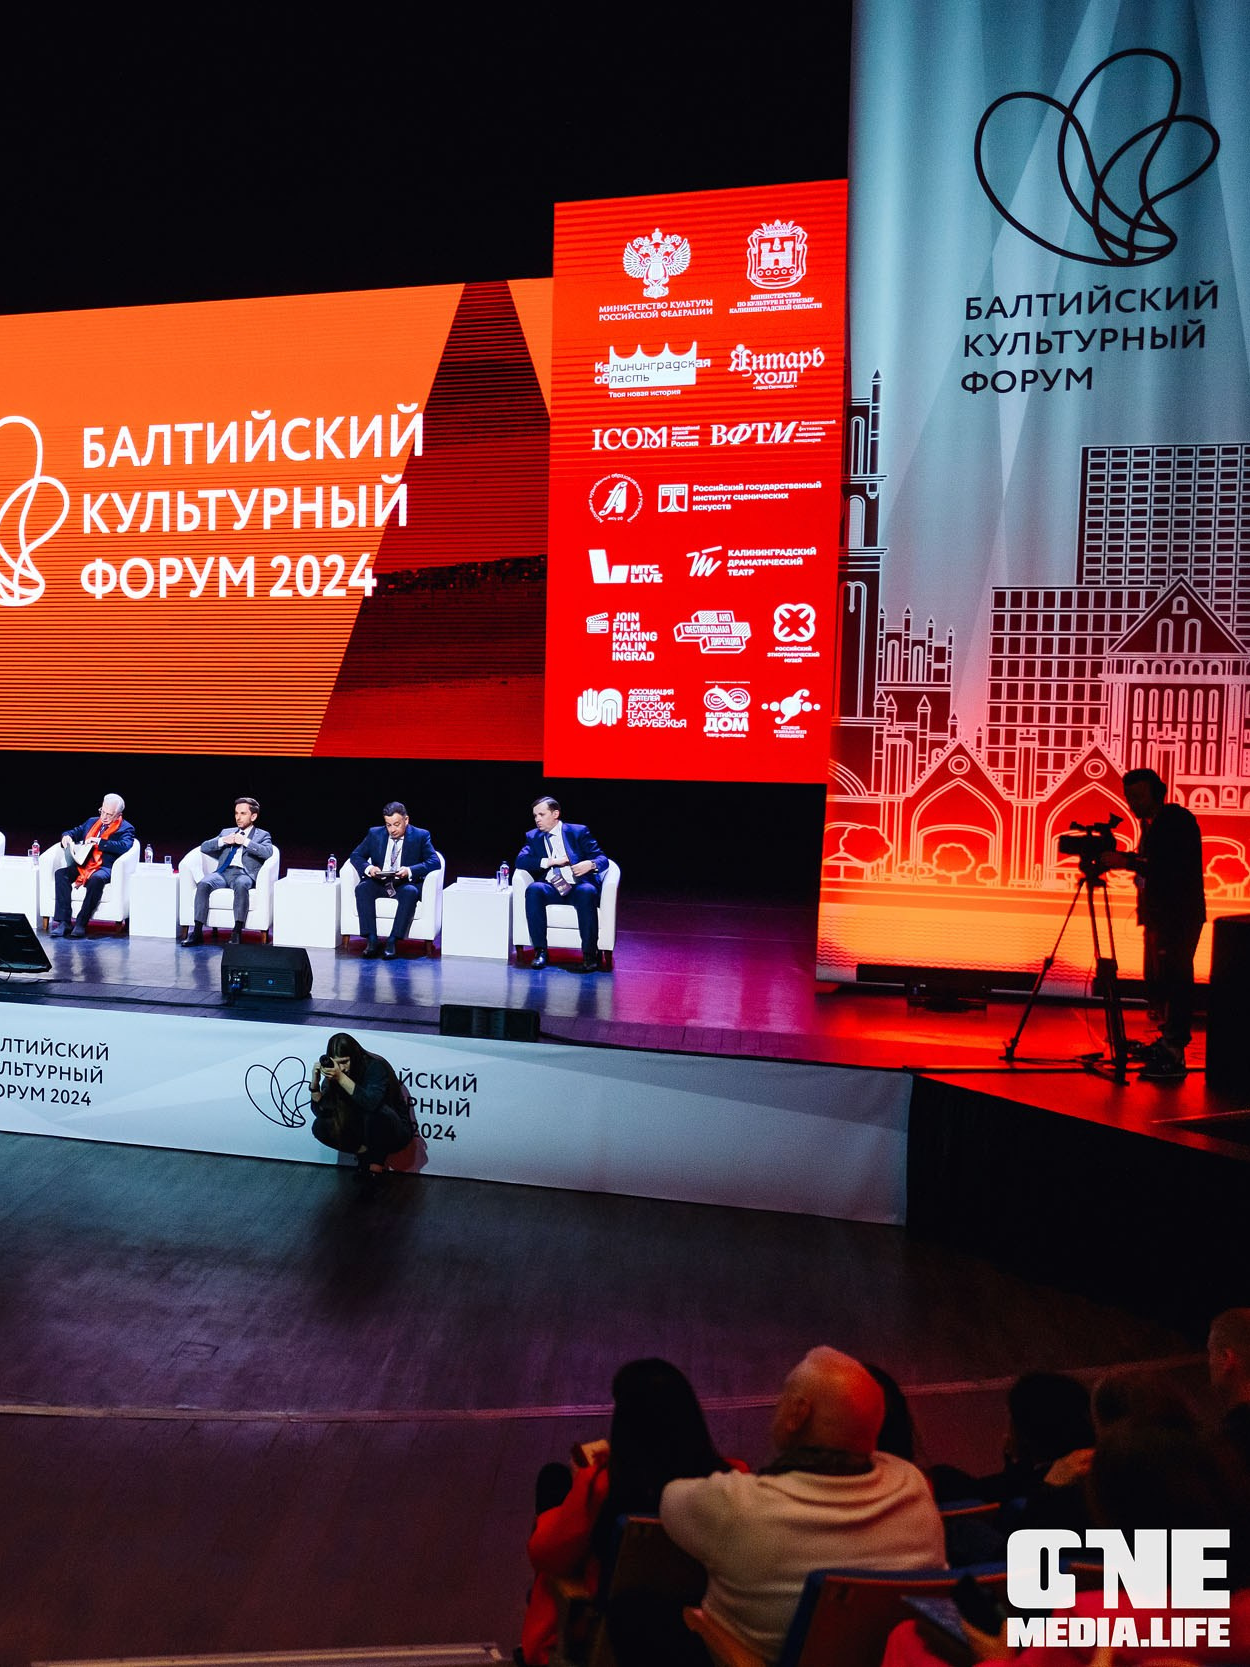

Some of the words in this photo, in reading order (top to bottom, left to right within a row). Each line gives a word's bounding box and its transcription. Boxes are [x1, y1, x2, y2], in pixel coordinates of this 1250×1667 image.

[965, 280, 1219, 320] БАЛТИЙСКИЙ
[599, 302, 668, 313] МИНИСТЕРСТВО
[670, 299, 713, 309] КУЛЬТУРЫ
[599, 310, 658, 321] РОССИЙСКОЙ
[661, 308, 713, 318] ФЕДЕРАЦИИ
[964, 319, 1206, 358] КУЛЬТУРНЫЙ
[594, 359, 711, 373] Калининградская
[594, 374, 650, 384] область
[753, 370, 798, 384] ХОЛЛ
[960, 367, 1093, 394] ФОРУМ
[83, 402, 424, 468] БАЛТИЙСКИЙ
[591, 426, 667, 450] ICOM
[710, 421, 799, 446] ВФТМ
[693, 484, 744, 492] Российский
[745, 481, 822, 491] государственный
[693, 494, 732, 502] институт
[733, 493, 789, 501] сценических
[83, 474, 407, 534] КУЛЬТУРНЫЙ
[728, 547, 817, 557] КАЛИНИНГРАДСКИЙ
[727, 557, 803, 567] ДРАМАТИЧЕСКИЙ
[631, 565, 659, 574] МТС
[728, 569, 754, 577] ТЕАТР
[80, 555, 255, 600] ФОРУМ
[269, 553, 377, 598] 2024
[630, 574, 663, 583] LIVE
[613, 612, 639, 622] JOIN
[612, 622, 640, 632] FILM
[612, 632, 658, 642] MAKING
[612, 641, 647, 651] KALIN
[612, 651, 655, 661] INGRAD
[627, 702, 675, 711] РУССКИХ
[626, 710, 671, 719] ТЕАТРОВ
[627, 719, 687, 728] ЗАРУБЕЖЬЯ
[703, 717, 749, 733] ДОМ
[399, 1067, 477, 1093] ЙСКИЙ
[50, 1088, 92, 1106] 2024
